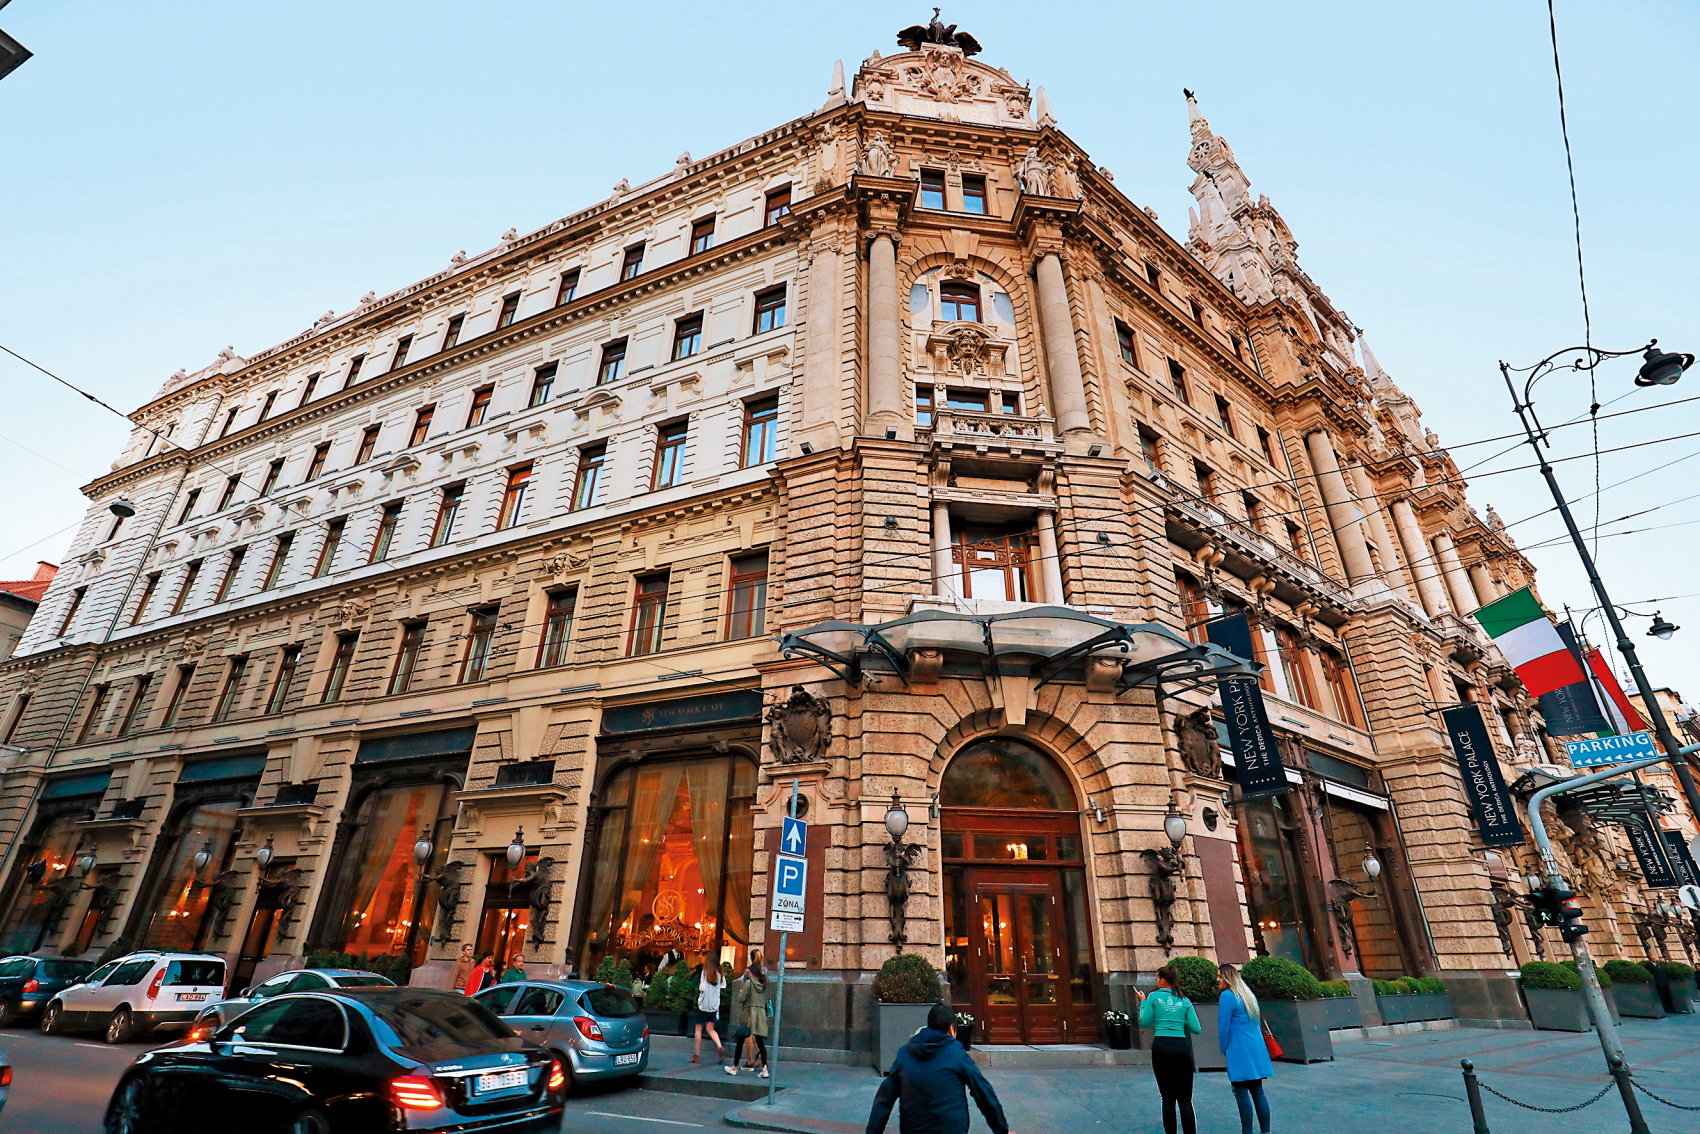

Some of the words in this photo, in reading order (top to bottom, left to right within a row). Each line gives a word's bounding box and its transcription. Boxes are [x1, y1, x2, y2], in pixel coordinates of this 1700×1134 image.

[1243, 682, 1259, 724] ANTHOLOGY
[1554, 688, 1566, 706] YOR
[677, 706, 701, 716] YORK
[1233, 694, 1251, 737] YORK
[1561, 705, 1572, 723] NEW
[1255, 725, 1267, 751] DEDICA
[1568, 735, 1649, 754] PARKING
[1240, 738, 1260, 771] NEW
[1260, 751, 1270, 767] THE
[1457, 730, 1480, 769] PALACE
[1470, 769, 1490, 801] YORK
[1482, 760, 1499, 792] ANTHOLOGY
[1493, 792, 1505, 813] DEDICA
[1481, 802, 1499, 827] NEW
[1499, 811, 1509, 825] THE
[1635, 836, 1650, 857] YORK
[782, 865, 799, 888] P
[1644, 857, 1658, 875] NEW
[777, 897, 799, 908] ZÓNA
